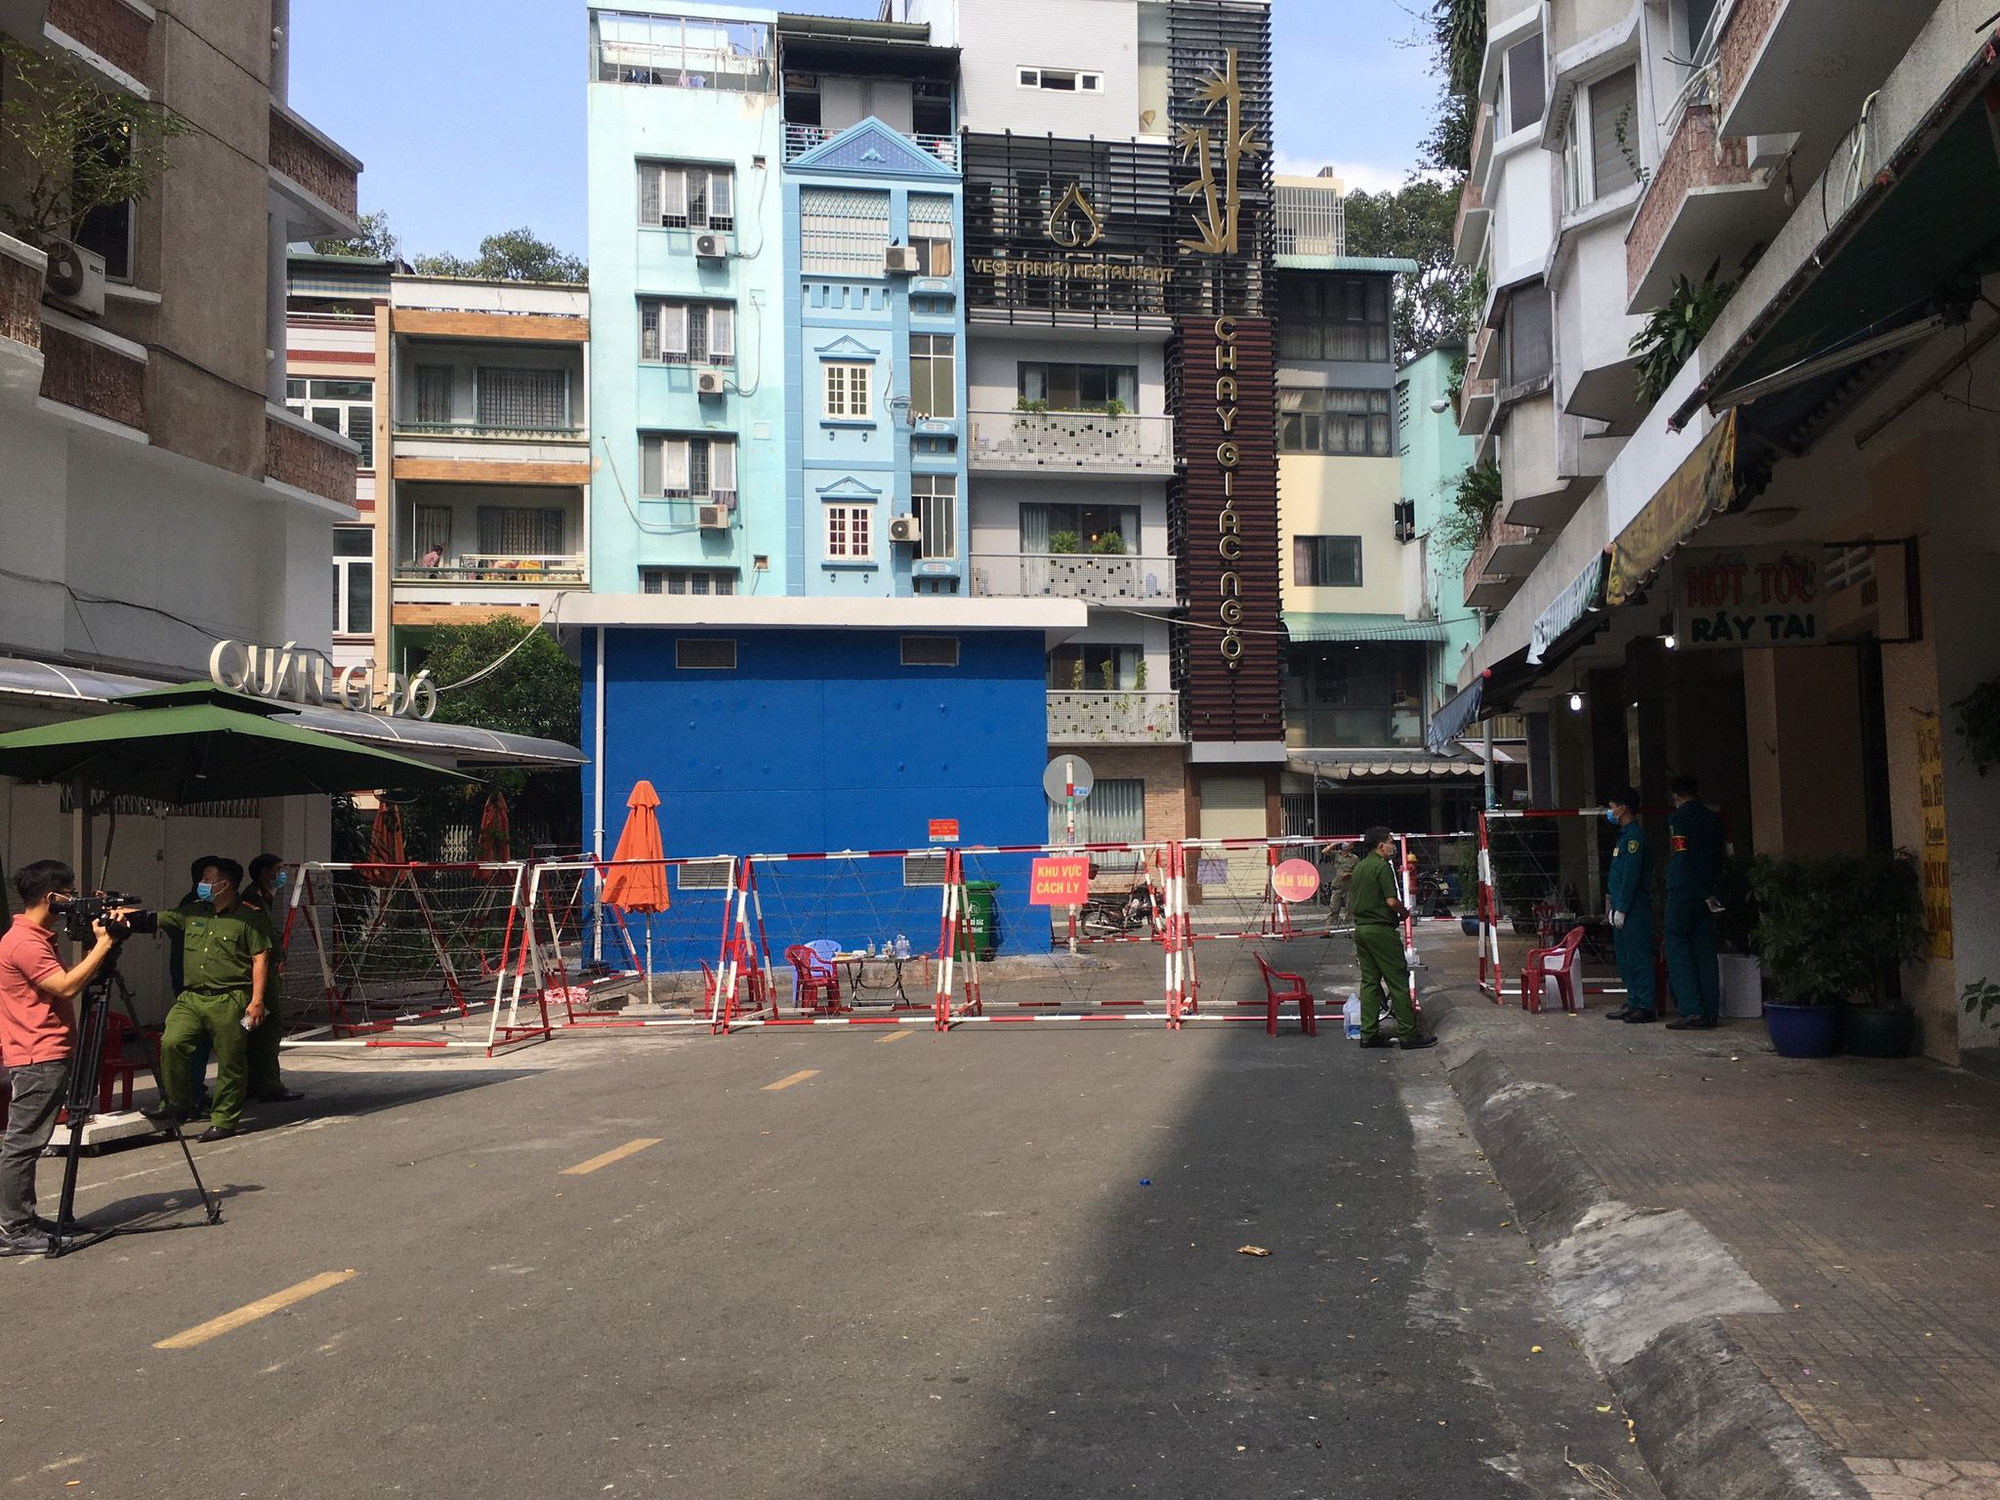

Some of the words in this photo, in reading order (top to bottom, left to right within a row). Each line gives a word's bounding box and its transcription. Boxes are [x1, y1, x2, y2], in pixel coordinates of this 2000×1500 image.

[971, 258, 1070, 277] VEGETARIAN
[1073, 263, 1174, 284] RESTAURANT
[1214, 316, 1239, 432] CHAY
[1217, 441, 1242, 561] GIÁC
[1219, 571, 1244, 670] NGỘ
[1691, 611, 1757, 642] RÁY
[1764, 614, 1816, 640] TAI
[209, 639, 325, 706] QUÁN
[1036, 879, 1064, 894] CÁCH
[1066, 883, 1080, 894] LY
[1038, 866, 1059, 877] KHU
[1061, 862, 1082, 880] VỰC
[1296, 872, 1315, 887] VÀO
